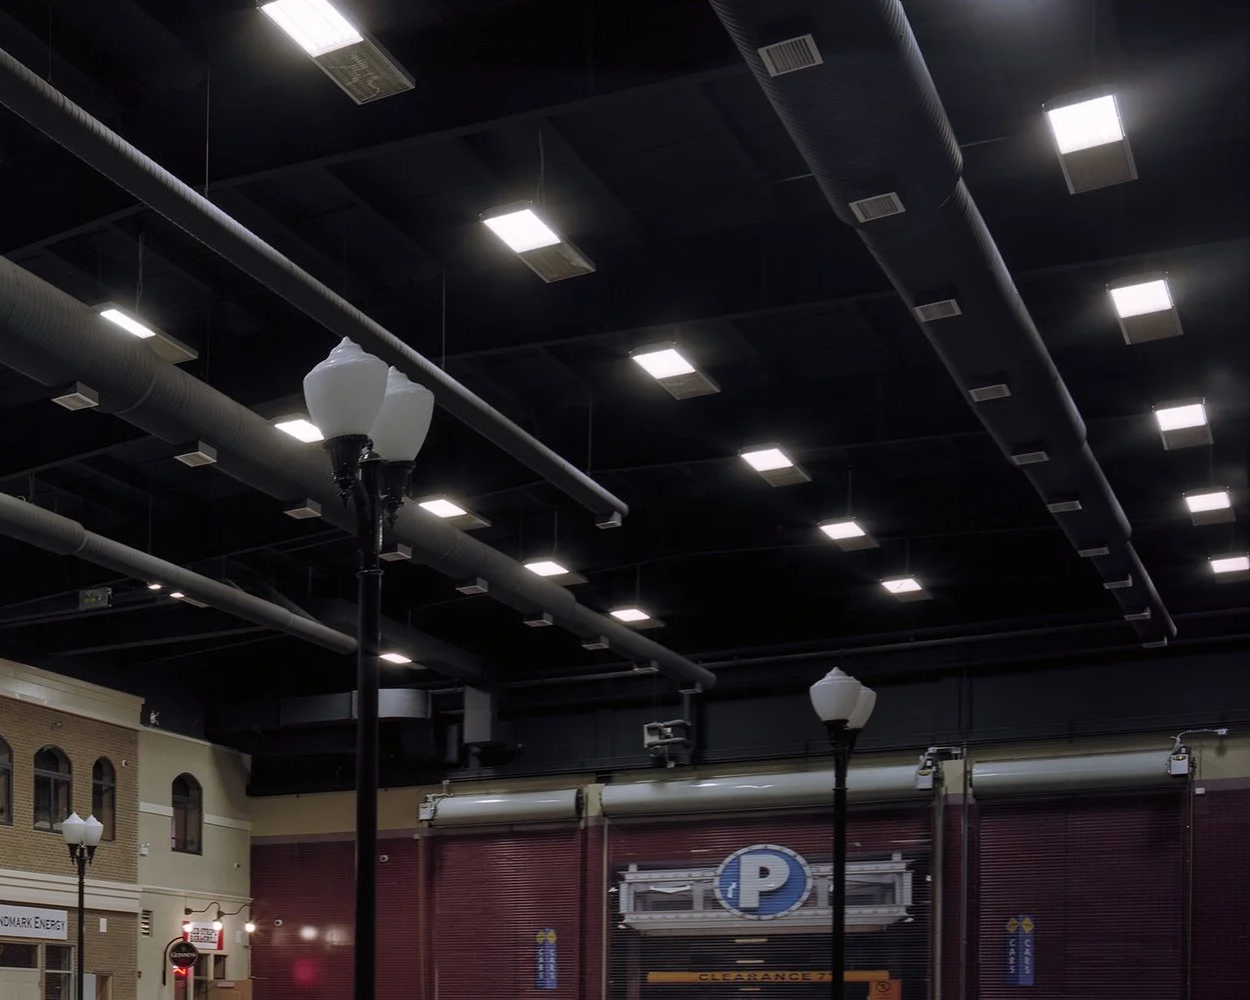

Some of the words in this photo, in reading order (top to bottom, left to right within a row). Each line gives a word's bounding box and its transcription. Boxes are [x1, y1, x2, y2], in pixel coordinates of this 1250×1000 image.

[739, 854, 790, 908] P
[34, 916, 66, 931] ENERGY
[698, 972, 812, 982] CLEARANCE
